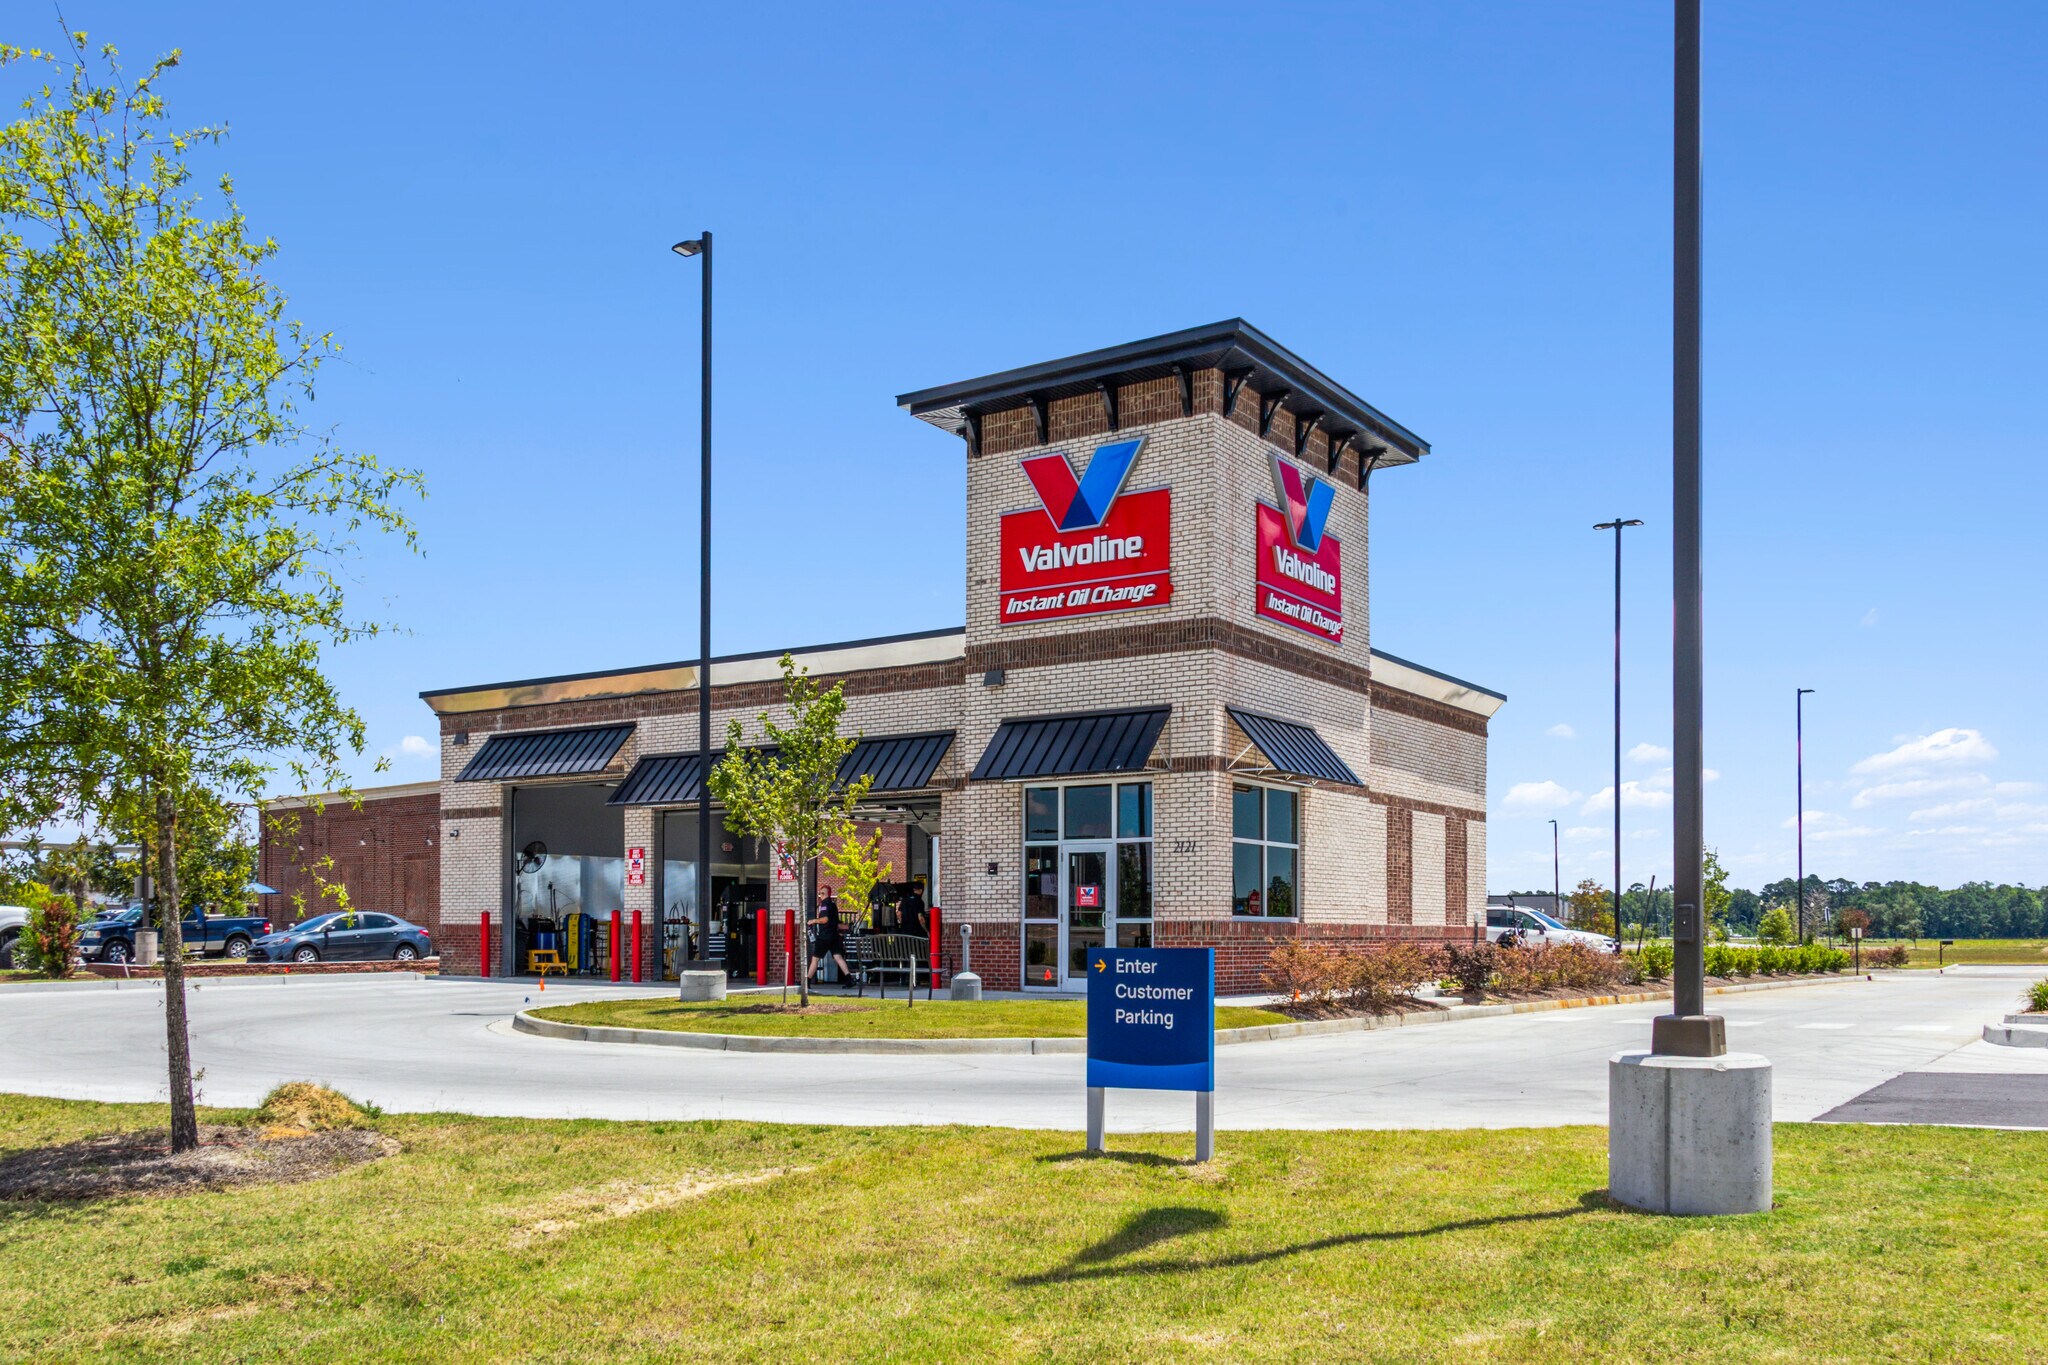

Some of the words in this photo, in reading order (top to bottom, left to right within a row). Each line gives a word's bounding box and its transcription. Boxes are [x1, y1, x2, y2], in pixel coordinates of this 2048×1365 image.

[1019, 535, 1144, 573] Valvoline
[1273, 545, 1336, 596] Valvoline
[1005, 592, 1065, 615] Instant
[1066, 585, 1092, 608] Oil
[1090, 583, 1158, 604] Change
[1267, 592, 1300, 619] Instant
[1300, 605, 1313, 623] Oil
[1312, 609, 1343, 635] Change
[1173, 841, 1197, 853] 2121
[1115, 958, 1158, 974] Enter
[1115, 983, 1194, 1000] Customer
[1115, 1008, 1174, 1030] Parking
